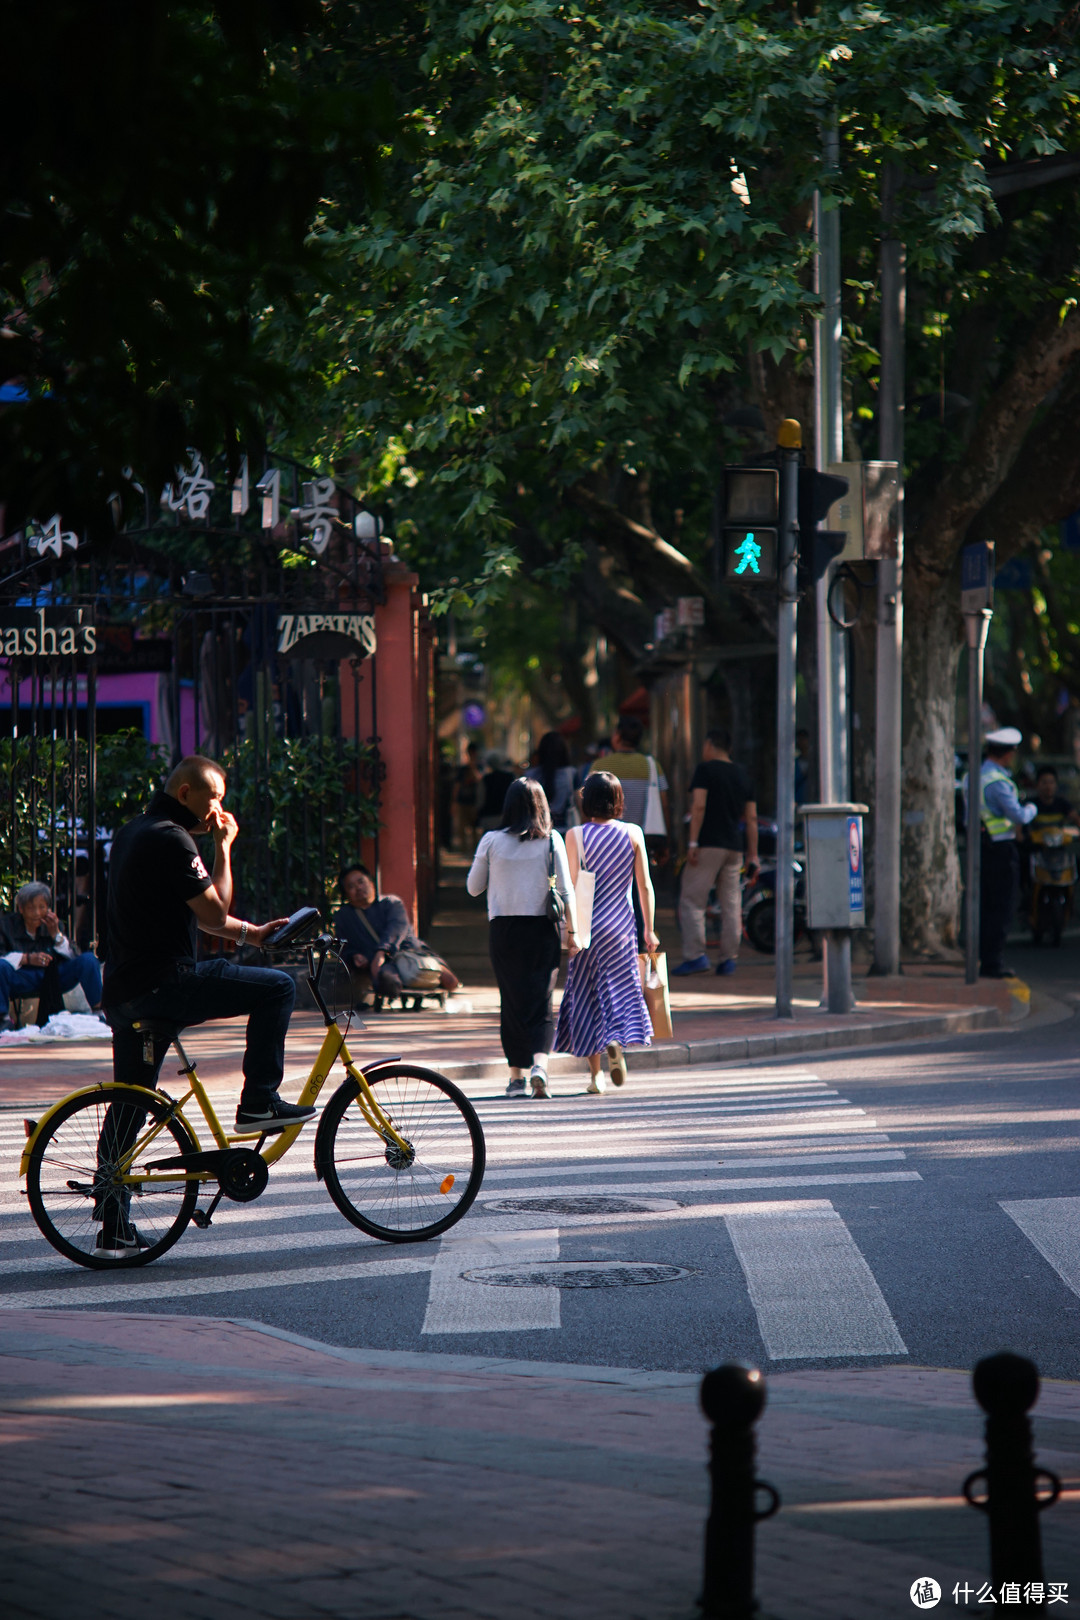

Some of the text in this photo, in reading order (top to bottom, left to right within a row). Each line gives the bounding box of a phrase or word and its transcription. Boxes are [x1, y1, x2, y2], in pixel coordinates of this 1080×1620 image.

[0, 607, 97, 657] asha's
[277, 614, 377, 655] ZAPATA'S
[310, 1074, 324, 1095] ofo
